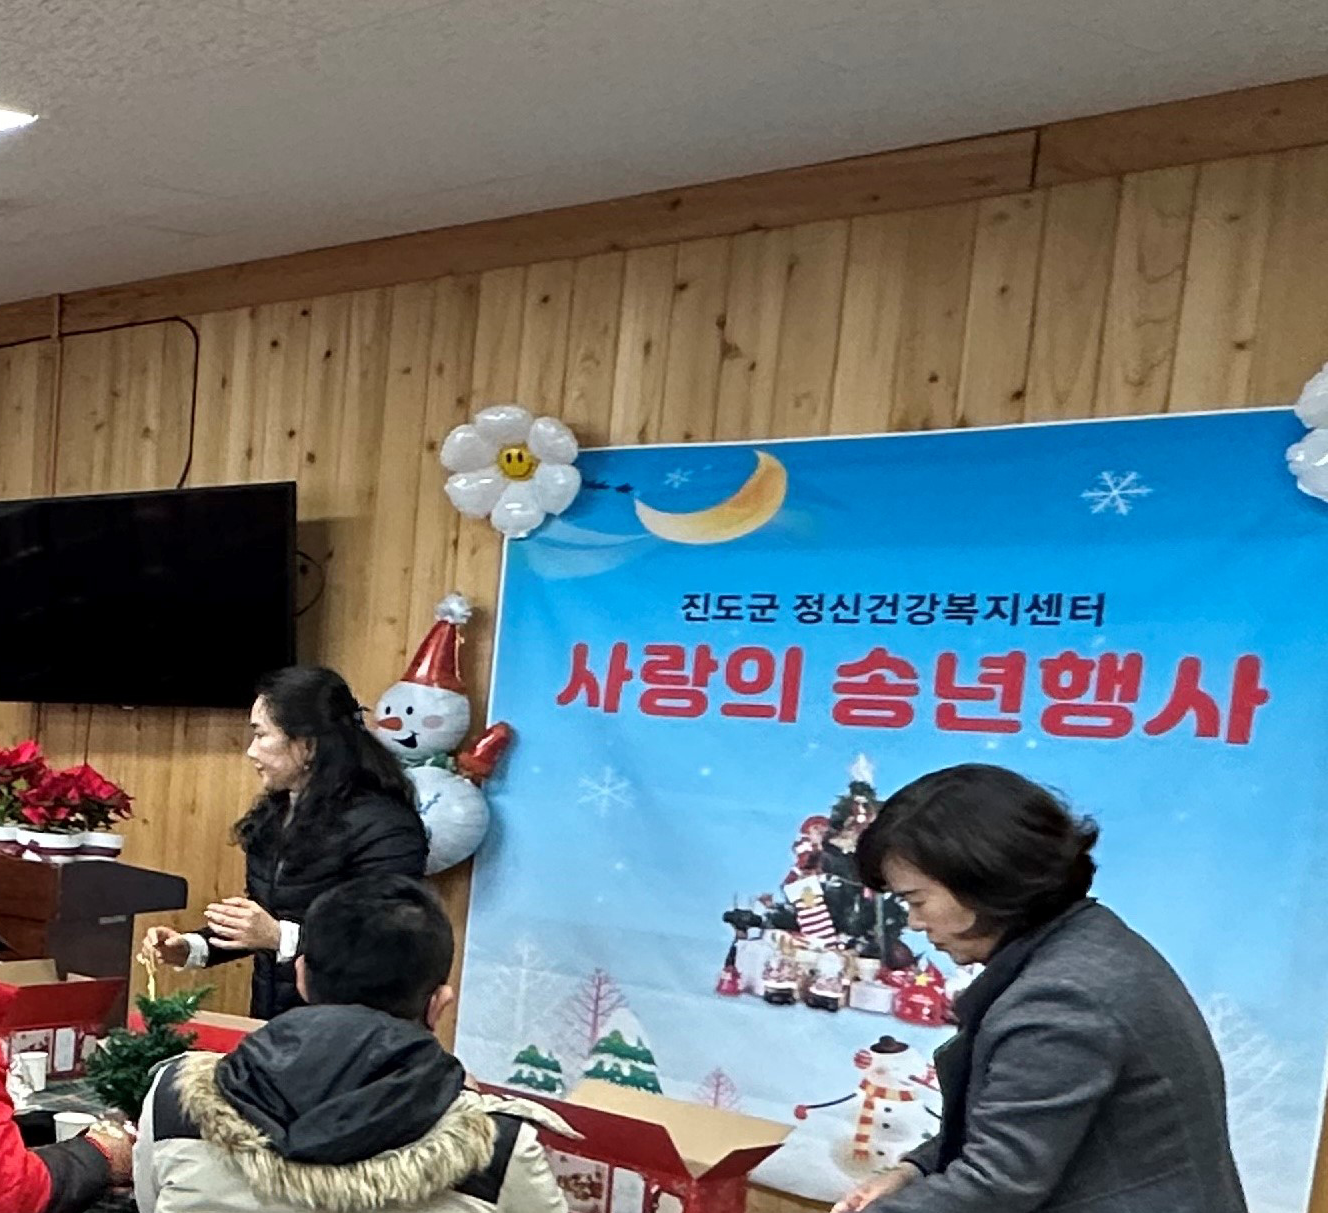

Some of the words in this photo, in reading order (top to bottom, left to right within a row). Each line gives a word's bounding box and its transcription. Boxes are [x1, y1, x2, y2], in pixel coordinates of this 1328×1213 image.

[681, 593, 780, 622] 진도군
[792, 592, 1107, 627] 정신건강복지센터
[555, 641, 805, 724] 사랑의
[831, 645, 1271, 746] 송년행사
